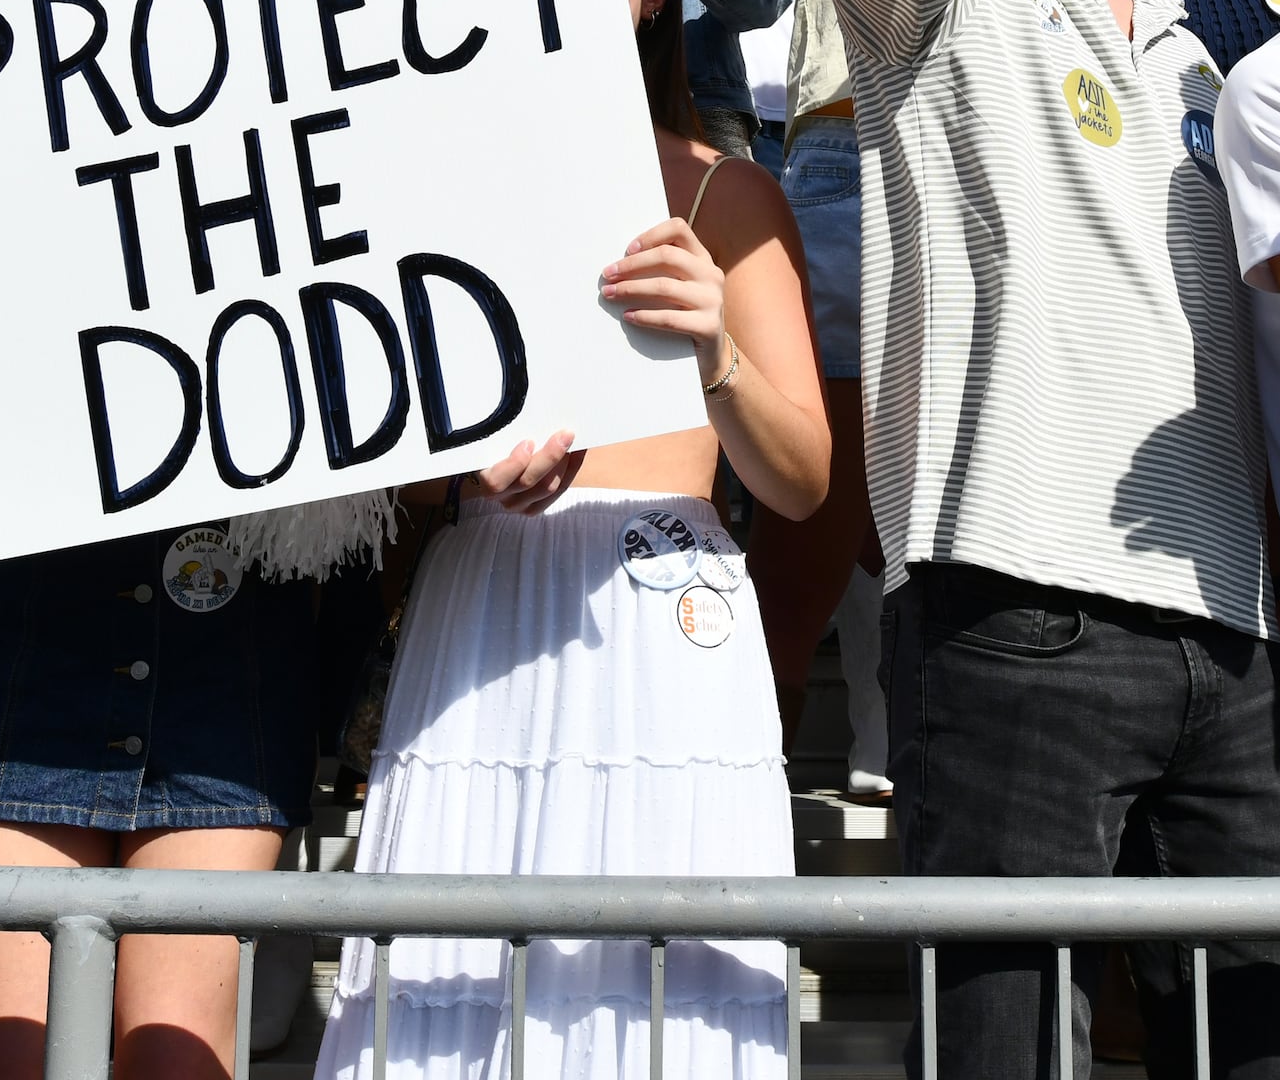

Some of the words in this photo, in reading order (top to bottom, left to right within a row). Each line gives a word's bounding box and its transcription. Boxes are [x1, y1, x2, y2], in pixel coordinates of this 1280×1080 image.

[1190, 120, 1214, 156] AD
[75, 107, 370, 312] THE
[77, 252, 529, 515] DODD
[175, 531, 241, 557] GAMED
[682, 597, 724, 617] Safety
[683, 616, 722, 634] Scho
